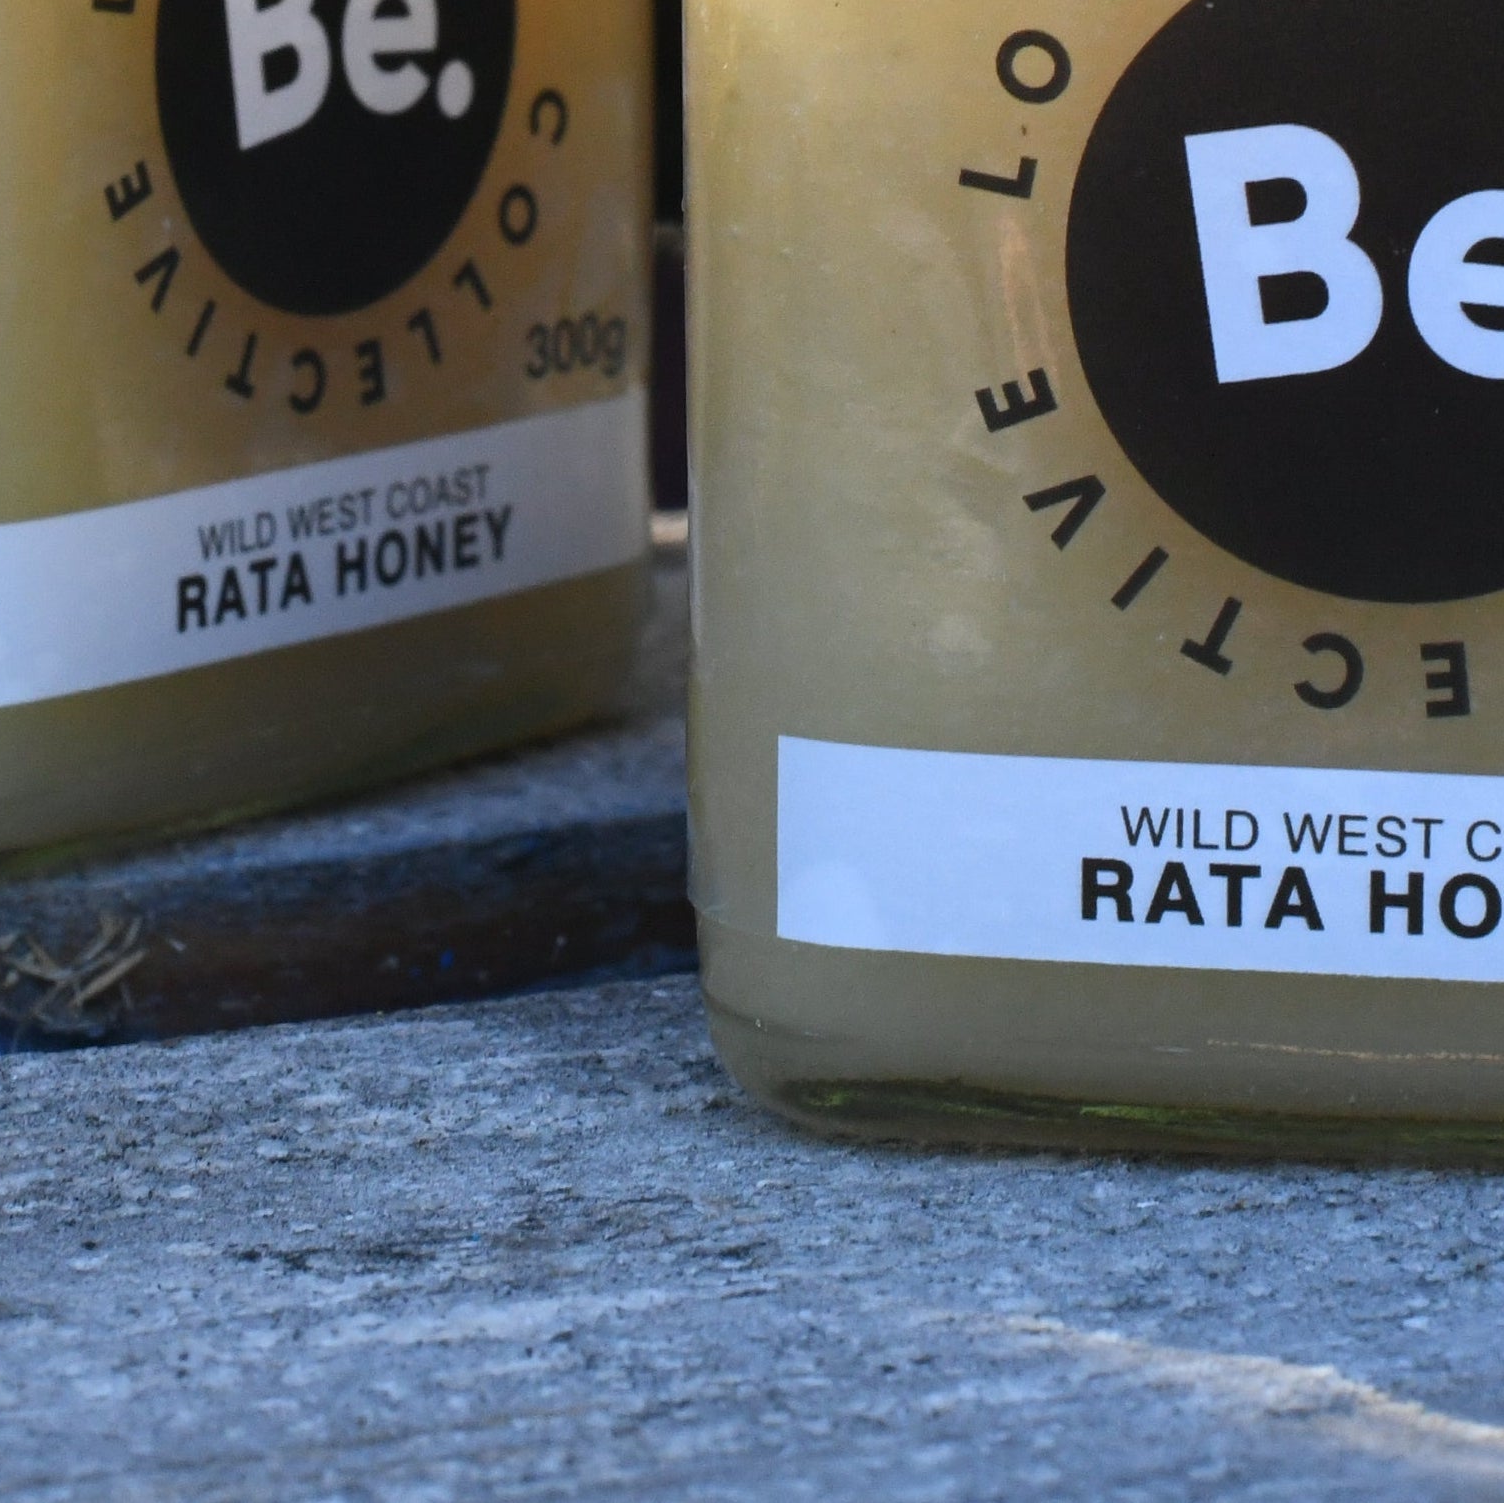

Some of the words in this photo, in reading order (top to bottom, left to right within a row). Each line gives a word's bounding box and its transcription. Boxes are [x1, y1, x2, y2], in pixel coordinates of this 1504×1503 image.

[104, 87, 569, 413] COLLECTIVE
[525, 311, 628, 382] 300g
[198, 509, 277, 561] WILD
[286, 486, 377, 540] WEST
[386, 463, 492, 522] COAST
[176, 552, 313, 634] RATA
[335, 504, 515, 596] HONEY
[1119, 804, 1260, 853] WILD
[1281, 811, 1445, 861] WEST
[1079, 856, 1324, 934] RATA
